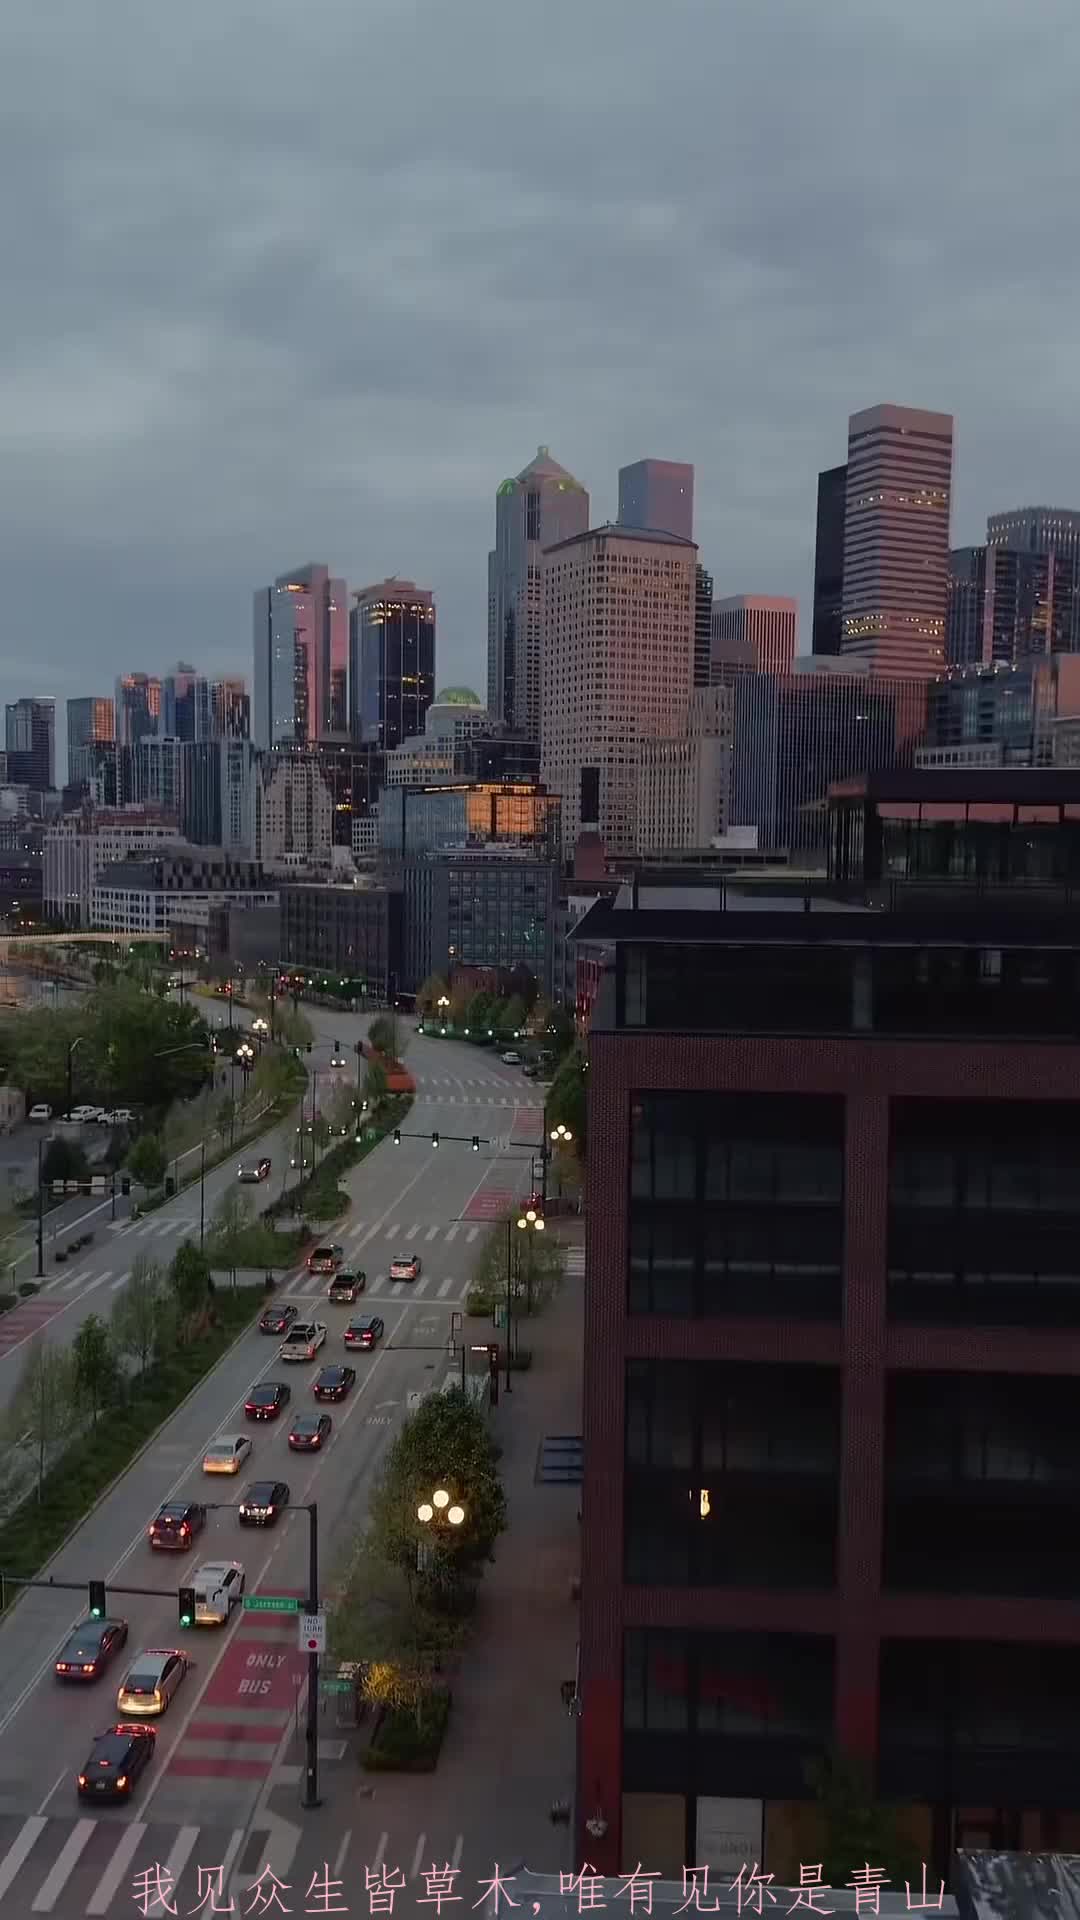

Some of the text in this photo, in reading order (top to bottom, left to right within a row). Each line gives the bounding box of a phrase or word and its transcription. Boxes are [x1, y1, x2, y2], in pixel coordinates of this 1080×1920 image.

[307, 1617, 318, 1625] NO
[246, 1654, 286, 1668] ONLY
[237, 1678, 272, 1694] BUS
